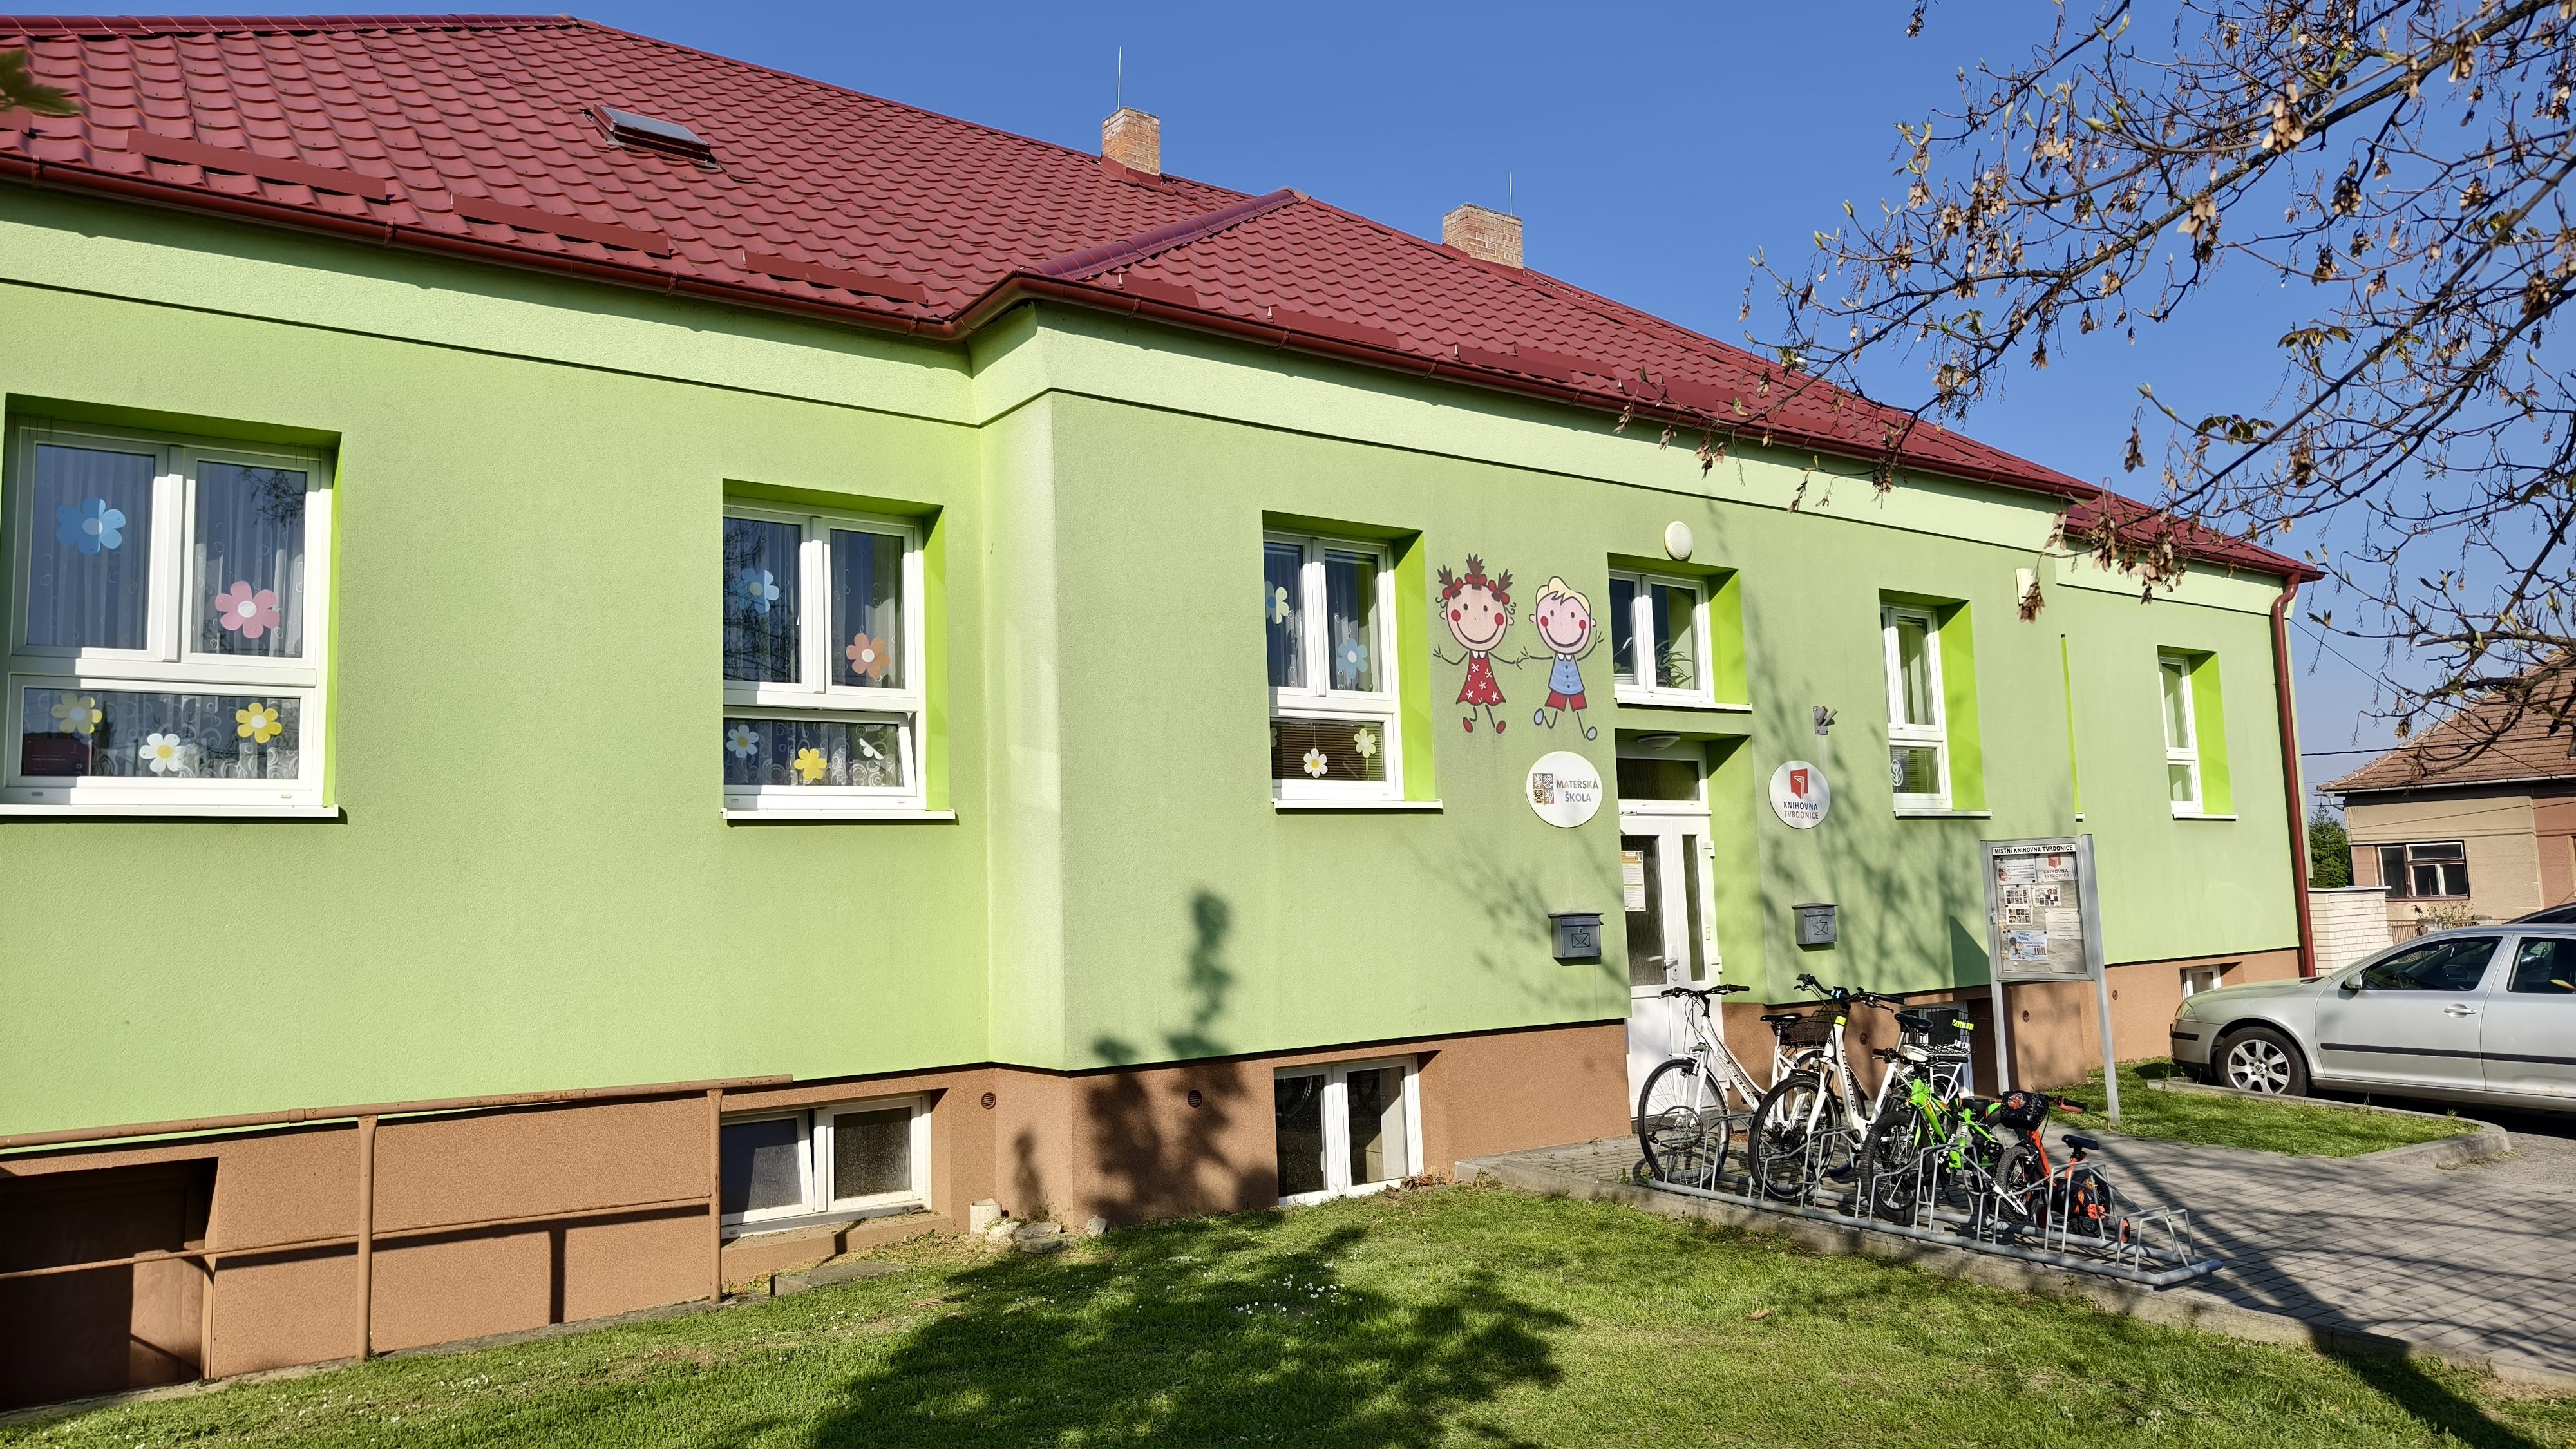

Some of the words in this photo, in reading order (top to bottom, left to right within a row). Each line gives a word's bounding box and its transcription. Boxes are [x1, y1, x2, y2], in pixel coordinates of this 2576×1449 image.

[1556, 778, 1598, 789] MATEŘSKÁ
[1565, 791, 1591, 802] ŠKOLA
[1783, 801, 1818, 810] KNIHOVNA
[1784, 811, 1819, 819] TVRDONICE
